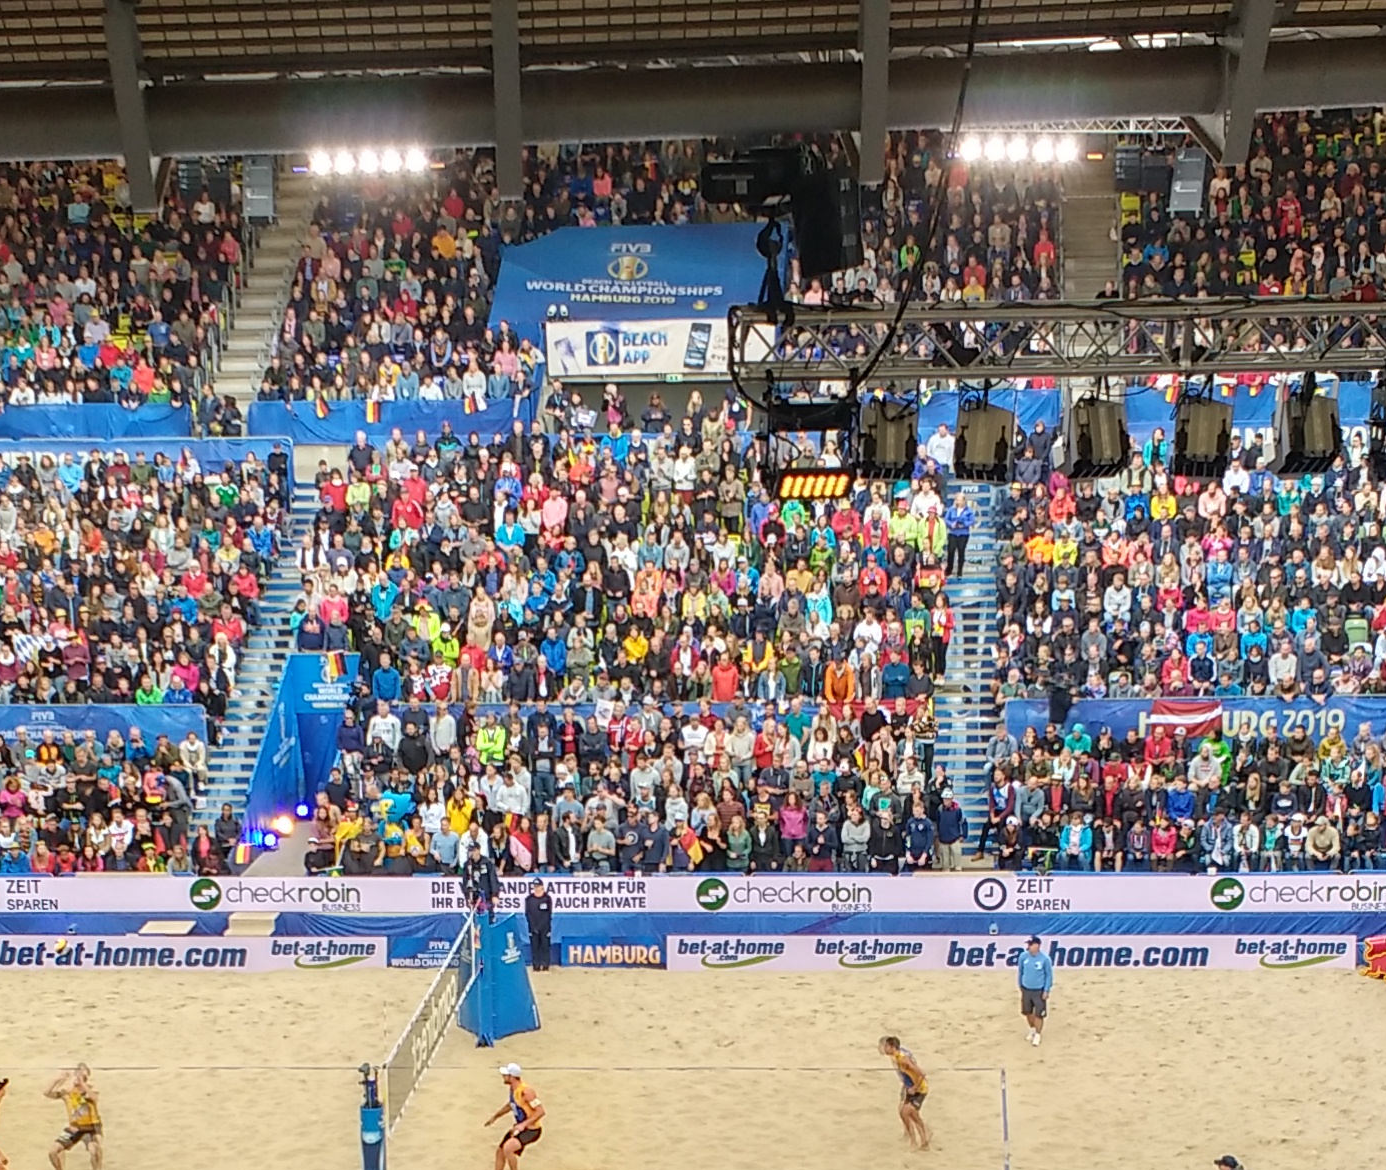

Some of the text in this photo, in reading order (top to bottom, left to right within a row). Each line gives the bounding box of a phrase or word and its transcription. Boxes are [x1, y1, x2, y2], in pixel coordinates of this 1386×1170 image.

[526, 281, 723, 296] WORLD CHAMPIONSHIPS
[570, 292, 676, 304] HAMBURG 2019
[622, 331, 668, 346] BEACH
[623, 350, 649, 364] APP
[1139, 709, 1345, 738] HURG 2019
[6, 880, 42, 894] ZEIT
[226, 881, 361, 903] checkrobin
[431, 878, 646, 894] DIE FÜR
[733, 881, 872, 903] checkrobin
[1016, 879, 1054, 893] ZEIT
[6, 899, 59, 910] SPAREN
[322, 903, 361, 911] BUSINESS
[431, 897, 454, 908] IHR
[555, 897, 589, 908] AUCH
[593, 897, 646, 908] PRIVATE
[831, 903, 872, 911] BUSINESS
[1016, 899, 1071, 910] SPAREN
[271, 940, 376, 955] bet-at-home
[677, 939, 785, 954] bet-at-home
[815, 939, 922, 954] bet-at-home
[946, 940, 1210, 966] bet-ahome.com
[1235, 938, 1347, 954] bet-at-home
[569, 945, 661, 964] HAMBURG
[391, 959, 421, 967] WORLD
